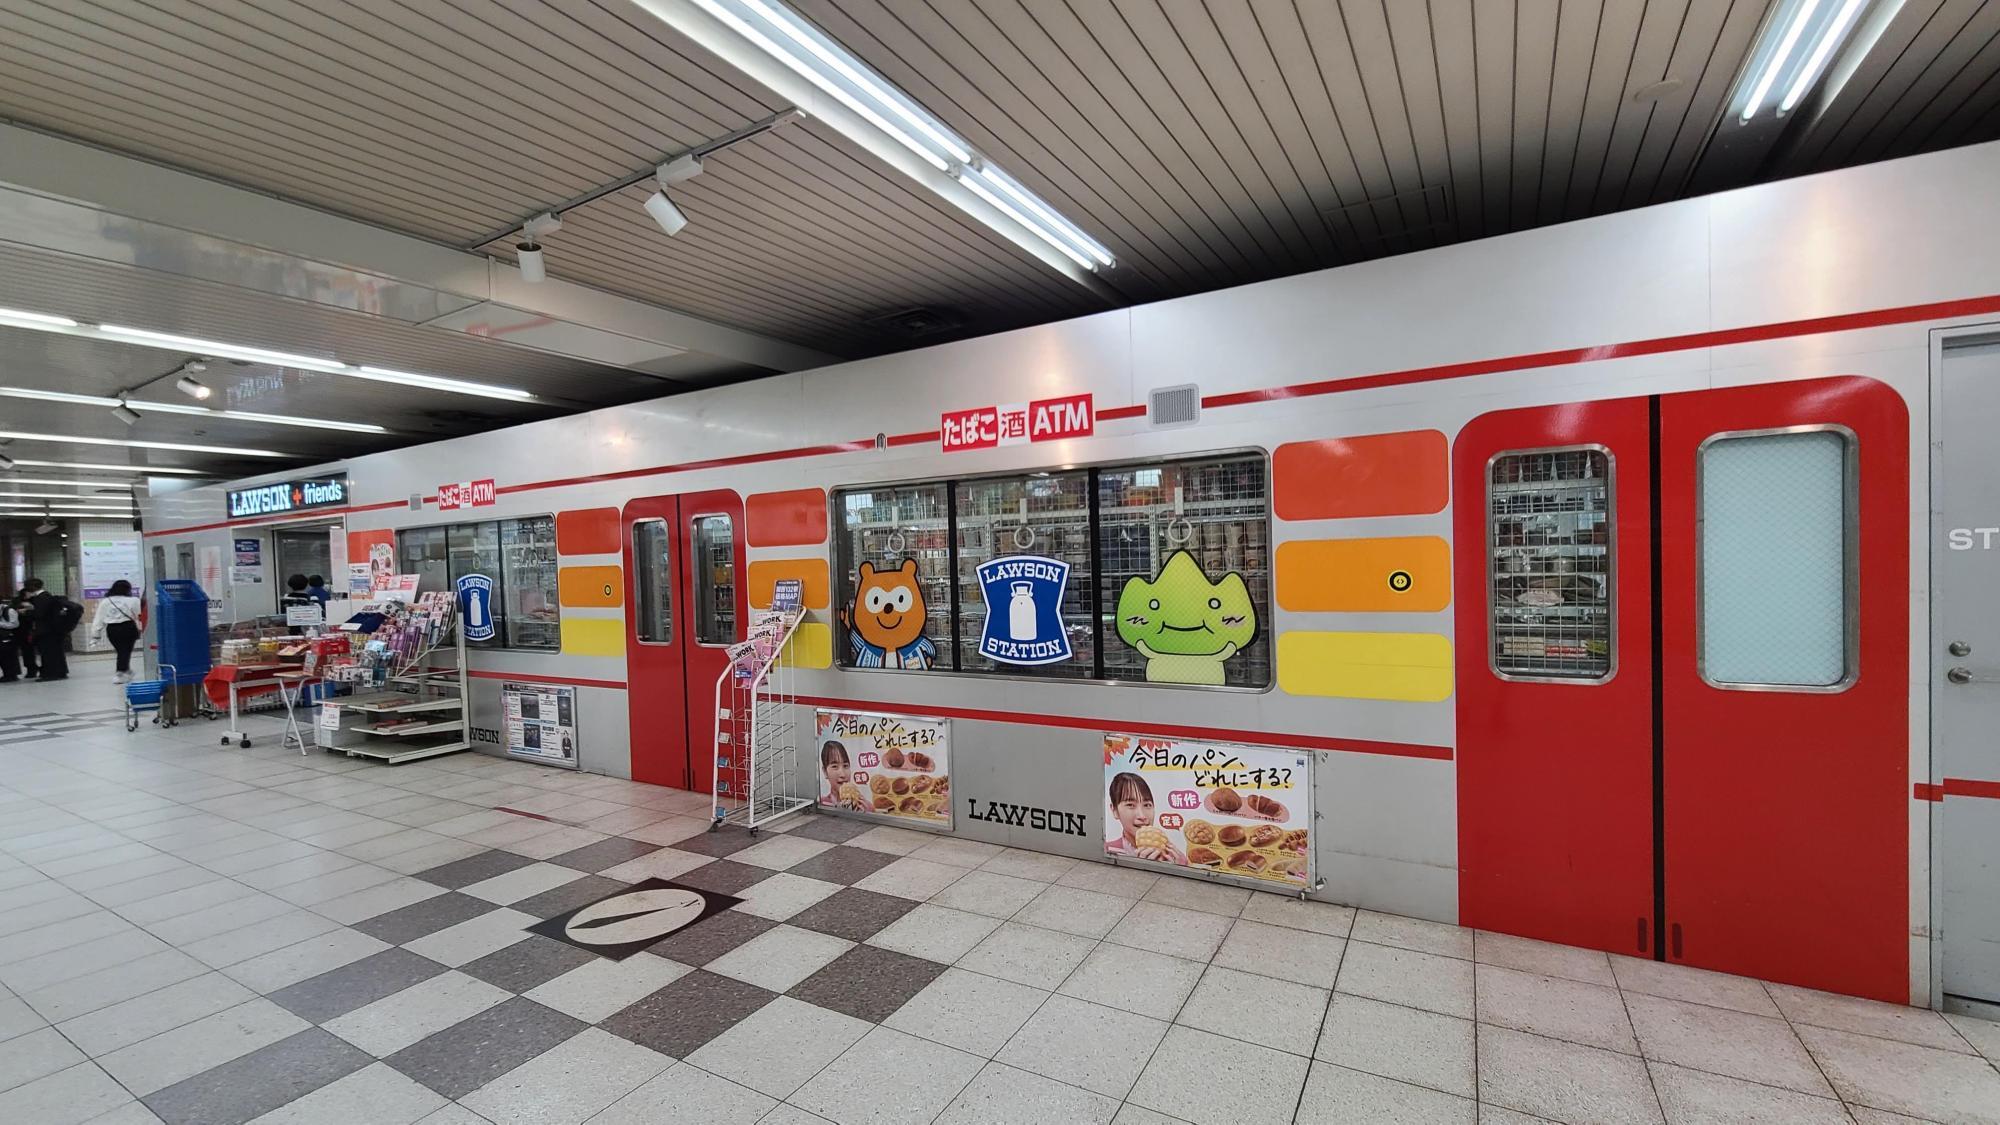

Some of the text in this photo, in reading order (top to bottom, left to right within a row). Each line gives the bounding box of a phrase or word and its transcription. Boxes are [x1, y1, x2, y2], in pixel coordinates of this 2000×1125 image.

[942, 401, 1090, 447] たばこ 酒 ATM
[231, 484, 291, 516] LAWSON
[303, 480, 343, 505] friends
[439, 486, 460, 507] たばこ
[473, 483, 494, 503] ATM
[1949, 527, 2000, 551] ST
[982, 560, 1061, 584] LAWSON
[459, 577, 490, 591] LAWSON
[762, 615, 782, 625] WORK
[754, 629, 771, 639] WORK
[735, 644, 755, 659] WORK
[986, 638, 1062, 659] STATION
[469, 727, 500, 744] WSON
[859, 754, 878, 767] 新作
[1170, 793, 1198, 808] 新作
[968, 798, 1087, 837] LAWSON
[1160, 814, 1182, 827] 定番
